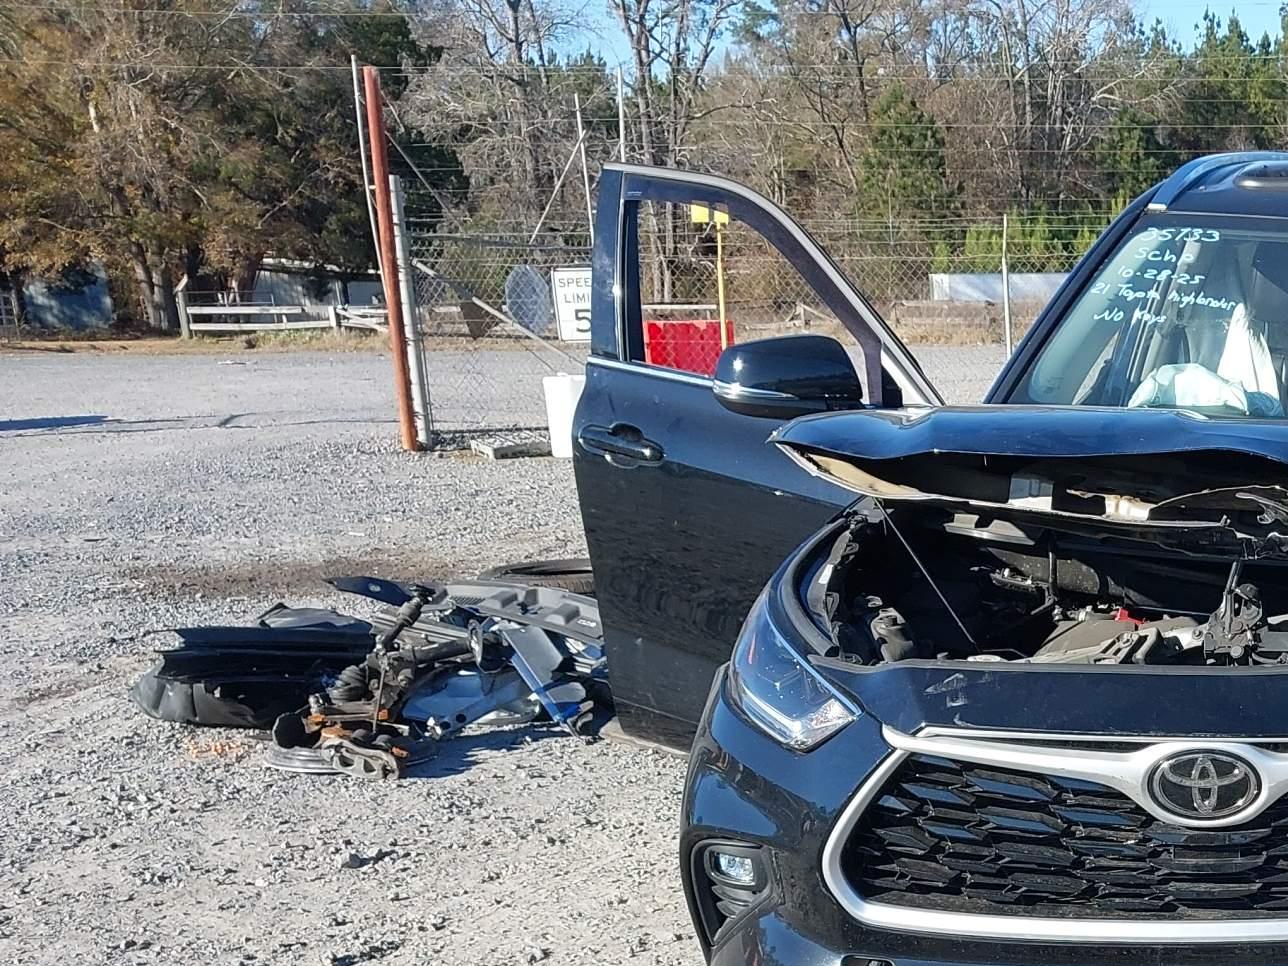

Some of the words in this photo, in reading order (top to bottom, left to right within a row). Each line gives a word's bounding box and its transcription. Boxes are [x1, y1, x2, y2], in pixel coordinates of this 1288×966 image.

[1117, 265, 1206, 285] 10-28-25
[558, 277, 591, 288] SPEE
[1090, 282, 1111, 295] 21
[564, 292, 591, 304] LIMI
[574, 308, 592, 333] 5
